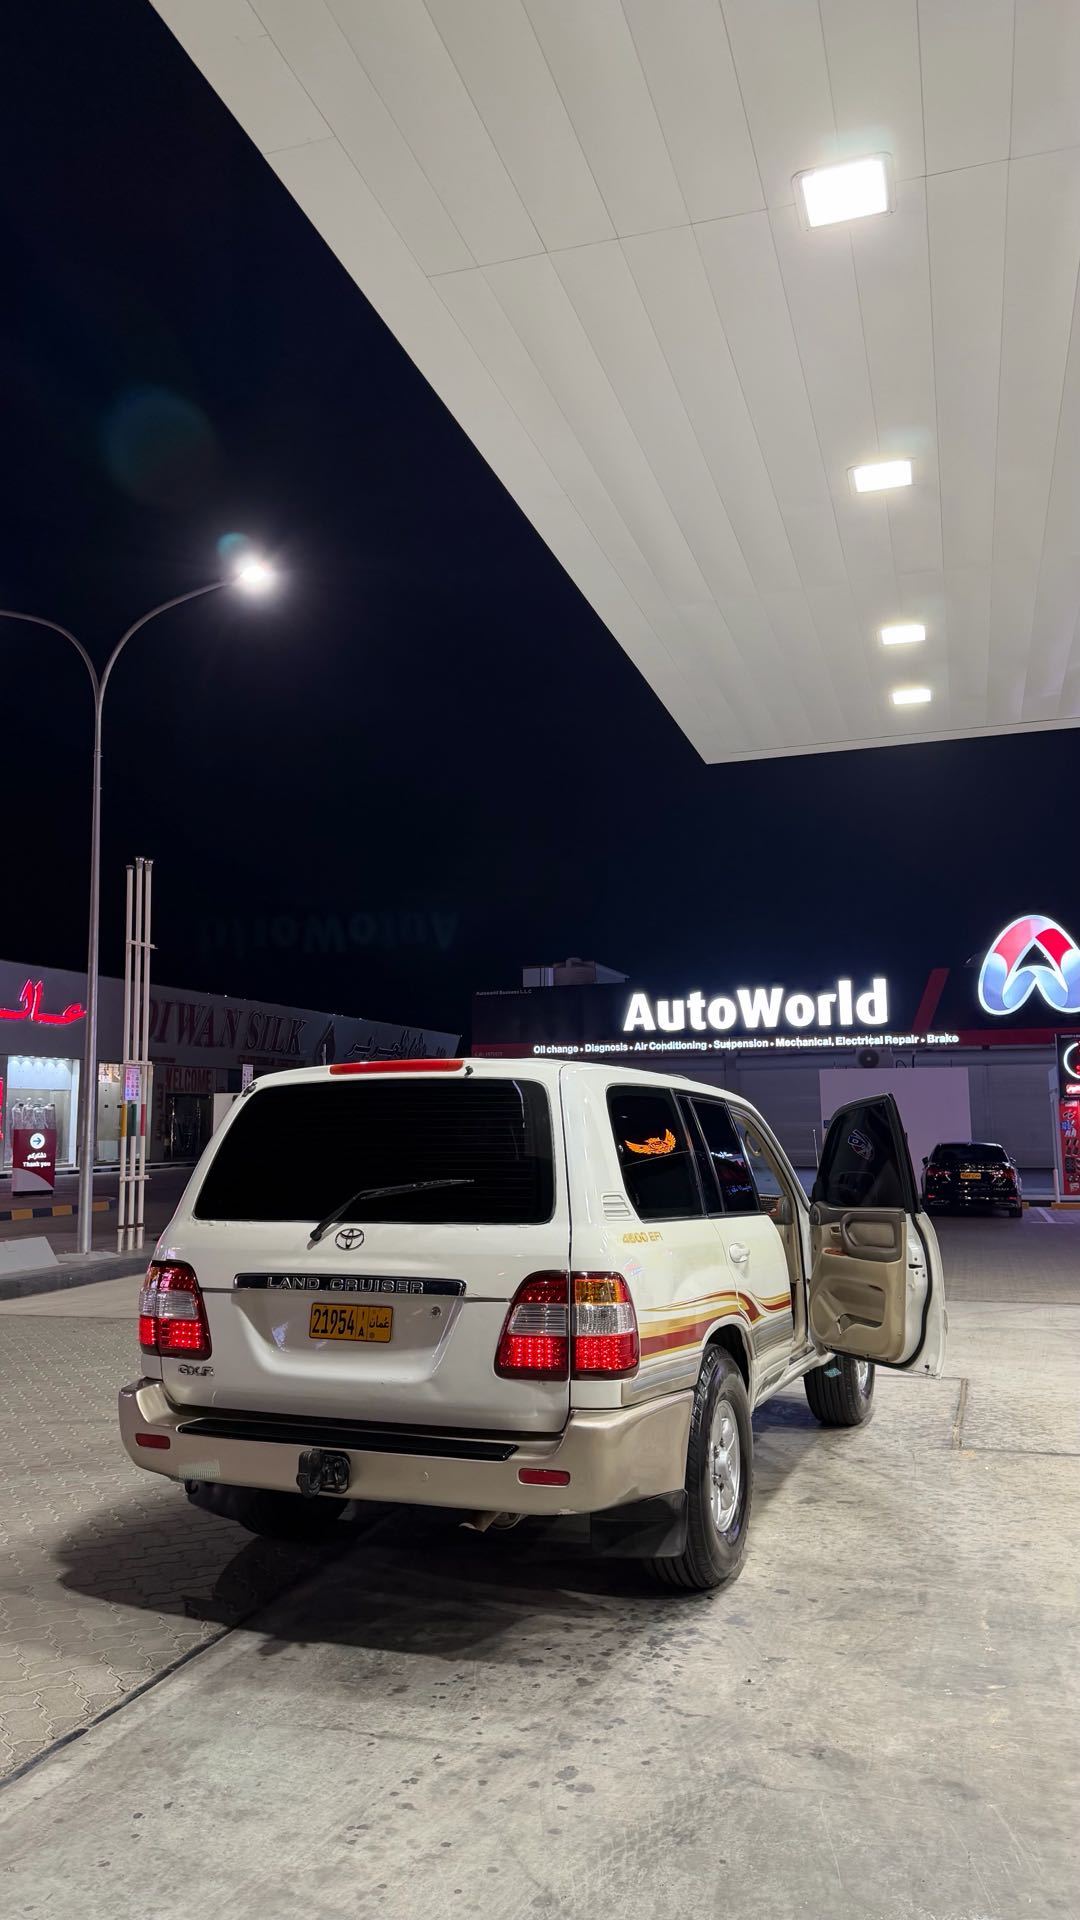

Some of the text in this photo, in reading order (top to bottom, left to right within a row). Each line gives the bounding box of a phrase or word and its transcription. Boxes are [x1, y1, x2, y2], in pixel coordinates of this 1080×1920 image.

[623, 978, 888, 1032] AutoWorld
[246, 1009, 308, 1056] SILK
[534, 1033, 960, 1055] Oil change Diagnosis Air Conditioning Suspension Mechanical, Electrical Repair Brake
[267, 1276, 424, 1294] LAND CRUISER
[311, 1308, 355, 1336] 21954
[358, 1326, 365, 1337] A
